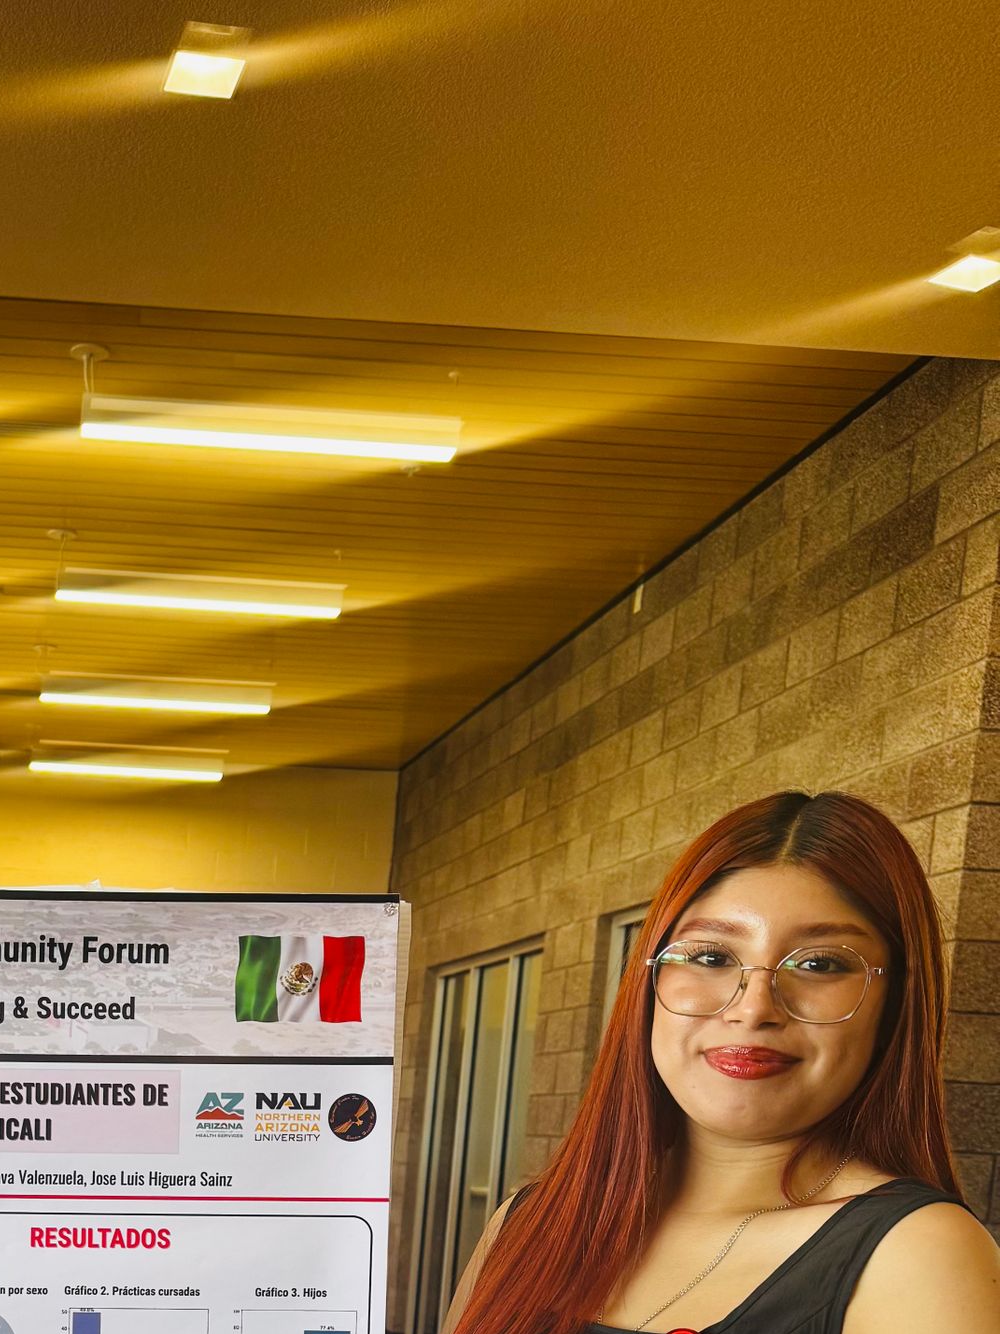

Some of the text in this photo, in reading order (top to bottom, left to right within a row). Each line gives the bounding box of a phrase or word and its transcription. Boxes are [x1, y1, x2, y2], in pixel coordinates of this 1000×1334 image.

[82, 935, 169, 964] Forum
[12, 995, 29, 1019] &
[36, 995, 135, 1020] Succeed
[0, 1081, 136, 1106] ESTUDIANTES
[142, 1083, 169, 1106] DE
[255, 1092, 322, 1110] NAU
[197, 1092, 244, 1115] AZ
[196, 1122, 243, 1130] ARIZONA
[255, 1113, 321, 1121] NORTHERN
[254, 1122, 321, 1132] ARIZONA
[254, 1133, 321, 1142] UNIVERSITY
[18, 1169, 87, 1187] Valenzuela,
[89, 1170, 116, 1186] Jose
[120, 1170, 145, 1186] Luis
[148, 1170, 196, 1189] Higuera
[199, 1171, 232, 1187] Sainz
[30, 1226, 171, 1249] RESULTADOS
[7, 1286, 24, 1296] por
[25, 1287, 48, 1295] sexo
[254, 1286, 327, 1300] Gráfico 3. Hijos
